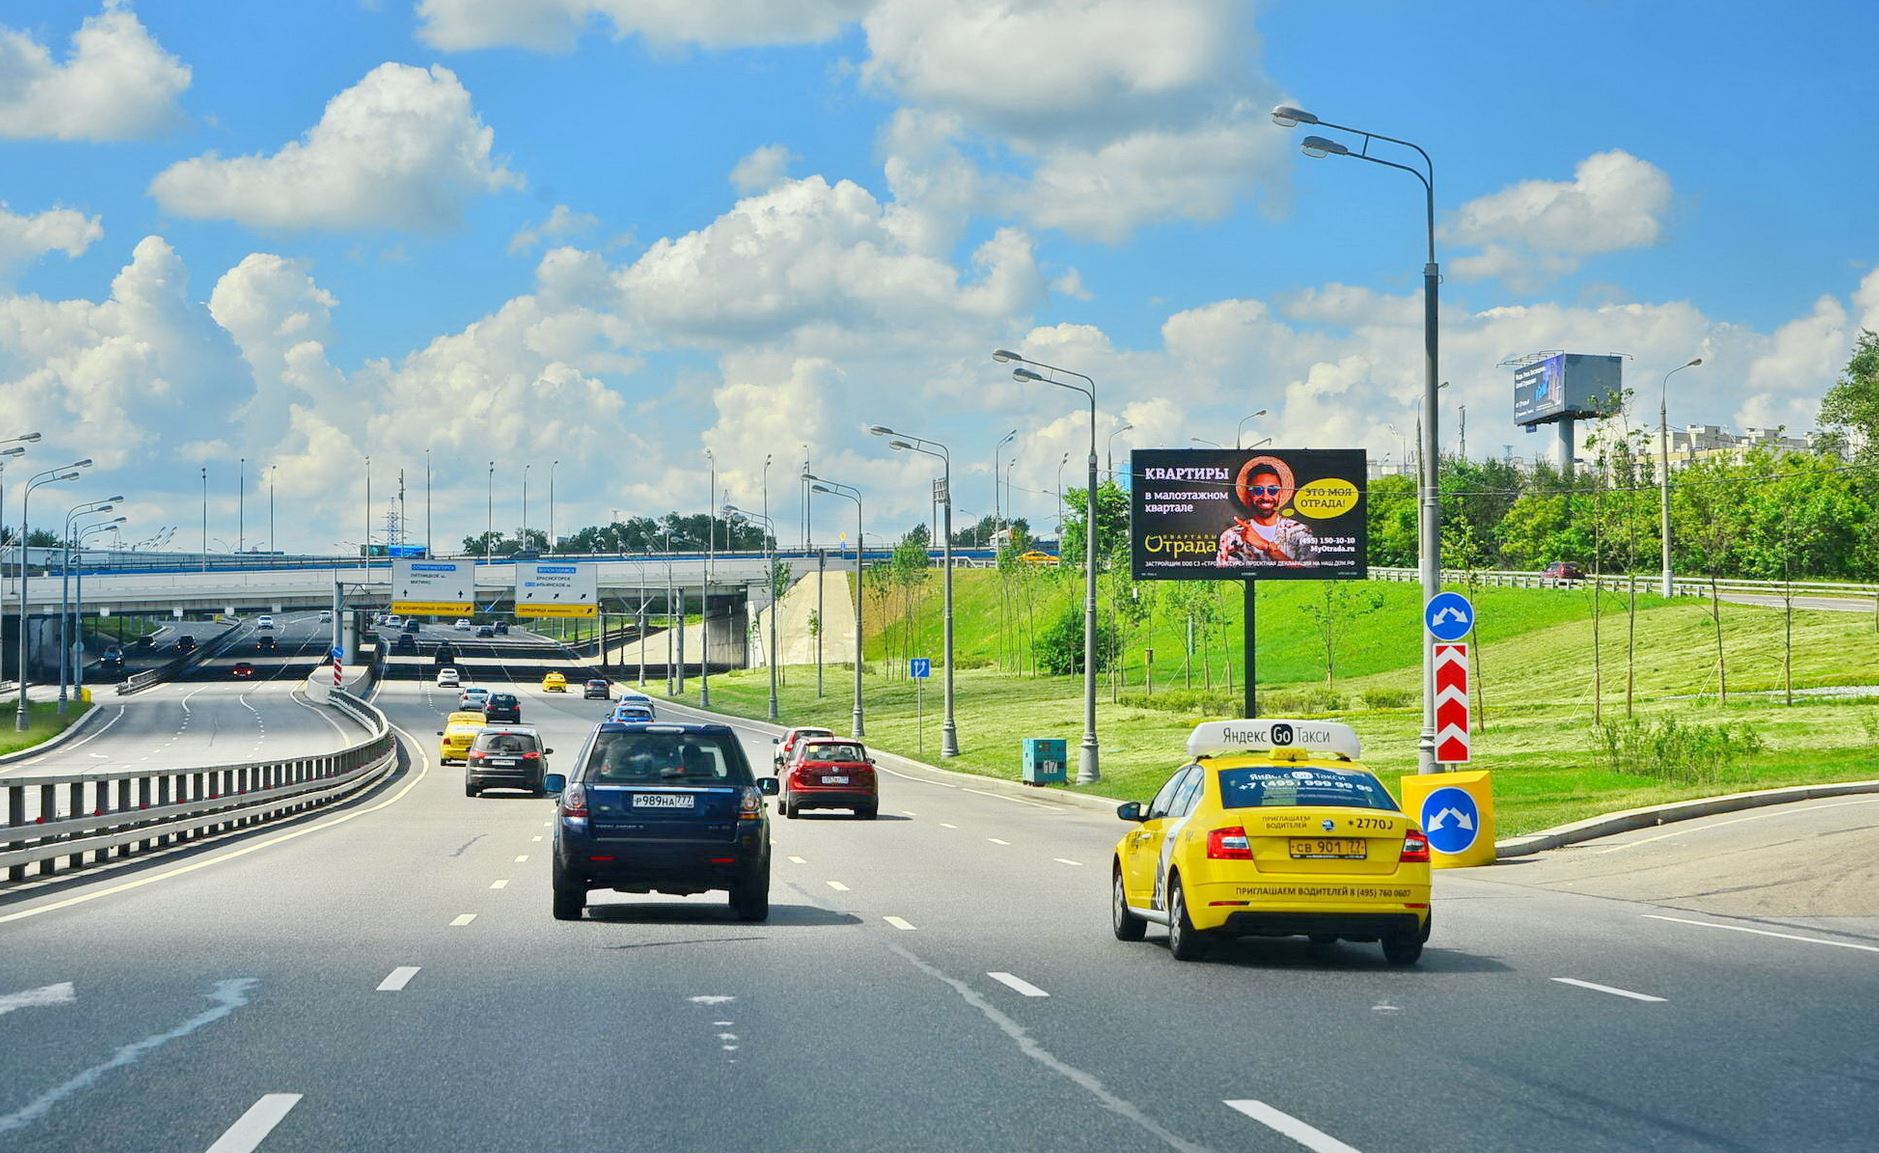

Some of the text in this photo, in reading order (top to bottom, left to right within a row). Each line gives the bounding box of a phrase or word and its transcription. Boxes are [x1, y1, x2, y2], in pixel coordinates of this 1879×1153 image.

[1144, 467, 1230, 480] КВАРТИРЫ
[1145, 491, 1229, 500] в малоэтажном
[1305, 488, 1352, 497] ЭТО МОЯ
[1144, 504, 1194, 514] квартале
[1300, 499, 1346, 509] ОТРАДА!
[1144, 534, 1217, 559] Отрада
[1310, 545, 1356, 553] MyOtrada.ru
[1223, 726, 1330, 744] Яндекс Go Такси
[1045, 760, 1057, 773] 17
[1239, 782, 1256, 790] +7
[636, 795, 675, 806] Р989НА
[1265, 821, 1307, 830] ВОДИТЕЛЕЙ
[1296, 843, 1312, 853] СВ
[1317, 841, 1341, 853] 901
[1236, 887, 1296, 895] ПРИГЛАШАЕМ
[1298, 886, 1348, 896] ВОДИТЕЛЕЙ
[1357, 888, 1377, 898] (495)
